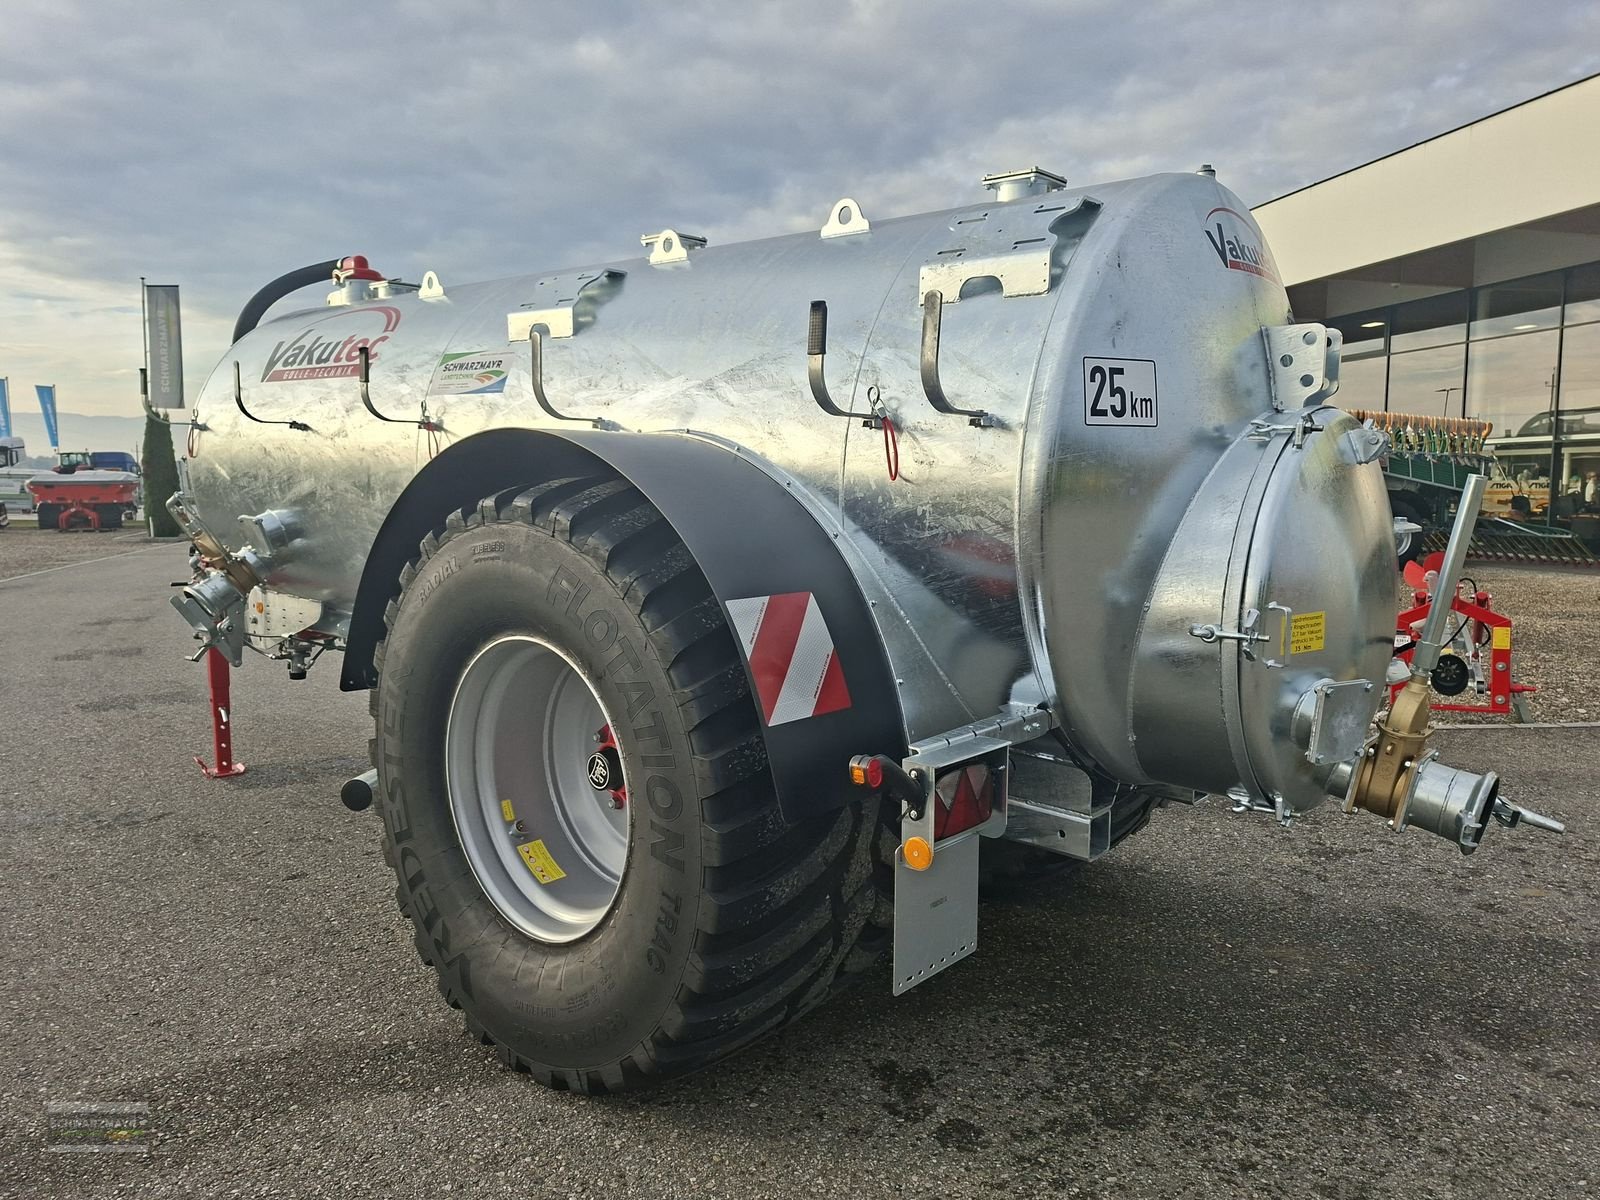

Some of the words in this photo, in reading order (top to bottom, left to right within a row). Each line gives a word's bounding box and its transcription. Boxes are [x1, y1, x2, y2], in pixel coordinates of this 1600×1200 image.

[157, 309, 170, 393] SCHWARZMAYR
[260, 328, 390, 383] Vakutec
[442, 360, 503, 373] SCHWARZMAYR
[1089, 365, 1127, 418] 25
[1130, 391, 1153, 418] km
[546, 564, 685, 874] FLOTATION
[384, 665, 475, 1001] VREDESTEIN
